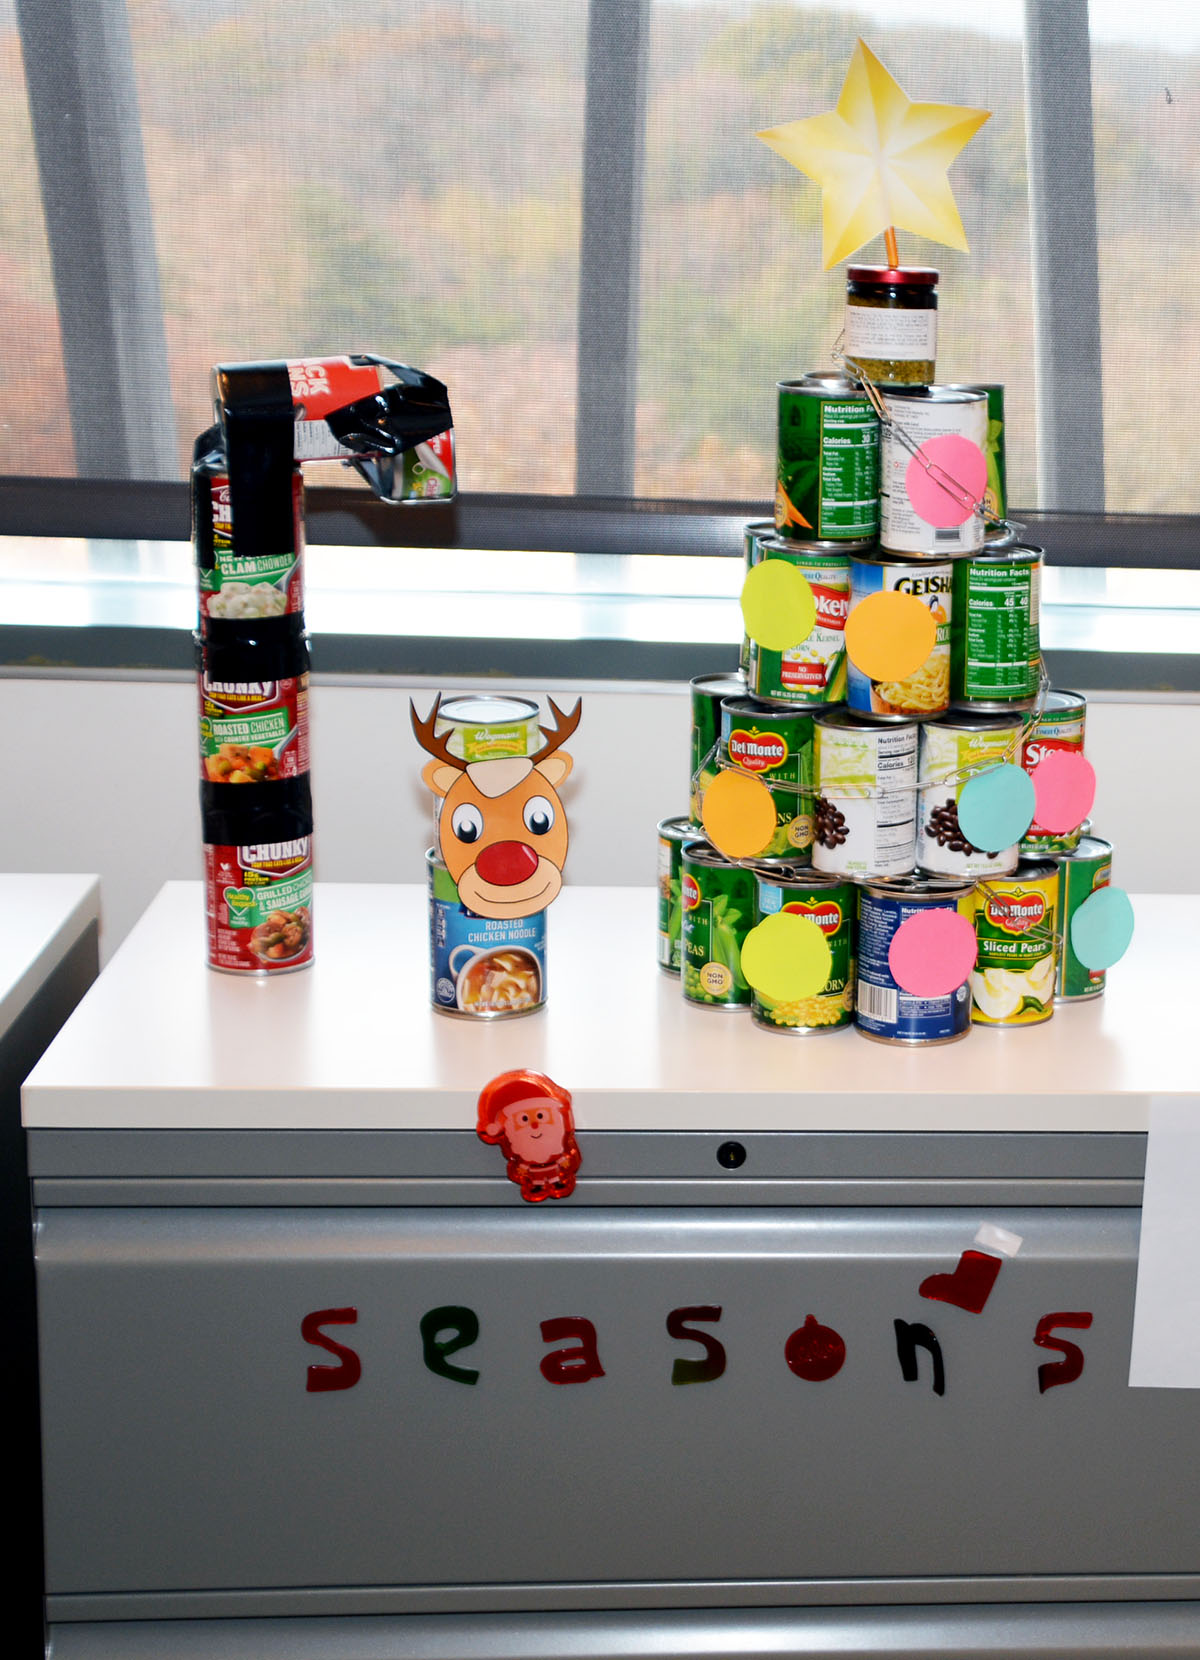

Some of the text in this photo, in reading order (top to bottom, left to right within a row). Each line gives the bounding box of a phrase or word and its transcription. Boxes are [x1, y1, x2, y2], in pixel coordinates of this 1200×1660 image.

[824, 405, 864, 413] Nutrition
[221, 555, 292, 575] CLAM CHOWDER
[969, 568, 1029, 577] Nutrition Facts
[968, 599, 993, 607] Calories
[213, 717, 284, 736] ROASTED CHICKEN
[877, 736, 905, 744] Nutrition
[731, 739, 784, 756] Del Monte
[877, 761, 904, 769] Calories
[242, 837, 308, 863] CHUNKY
[257, 886, 292, 900] GRILLED
[266, 892, 299, 909] SAUSAGE
[1010, 904, 1042, 917] Monte
[485, 919, 523, 931] ROASTED
[468, 928, 536, 942] CHICKEN NOODLE
[983, 940, 1046, 953] Sliced Pears
